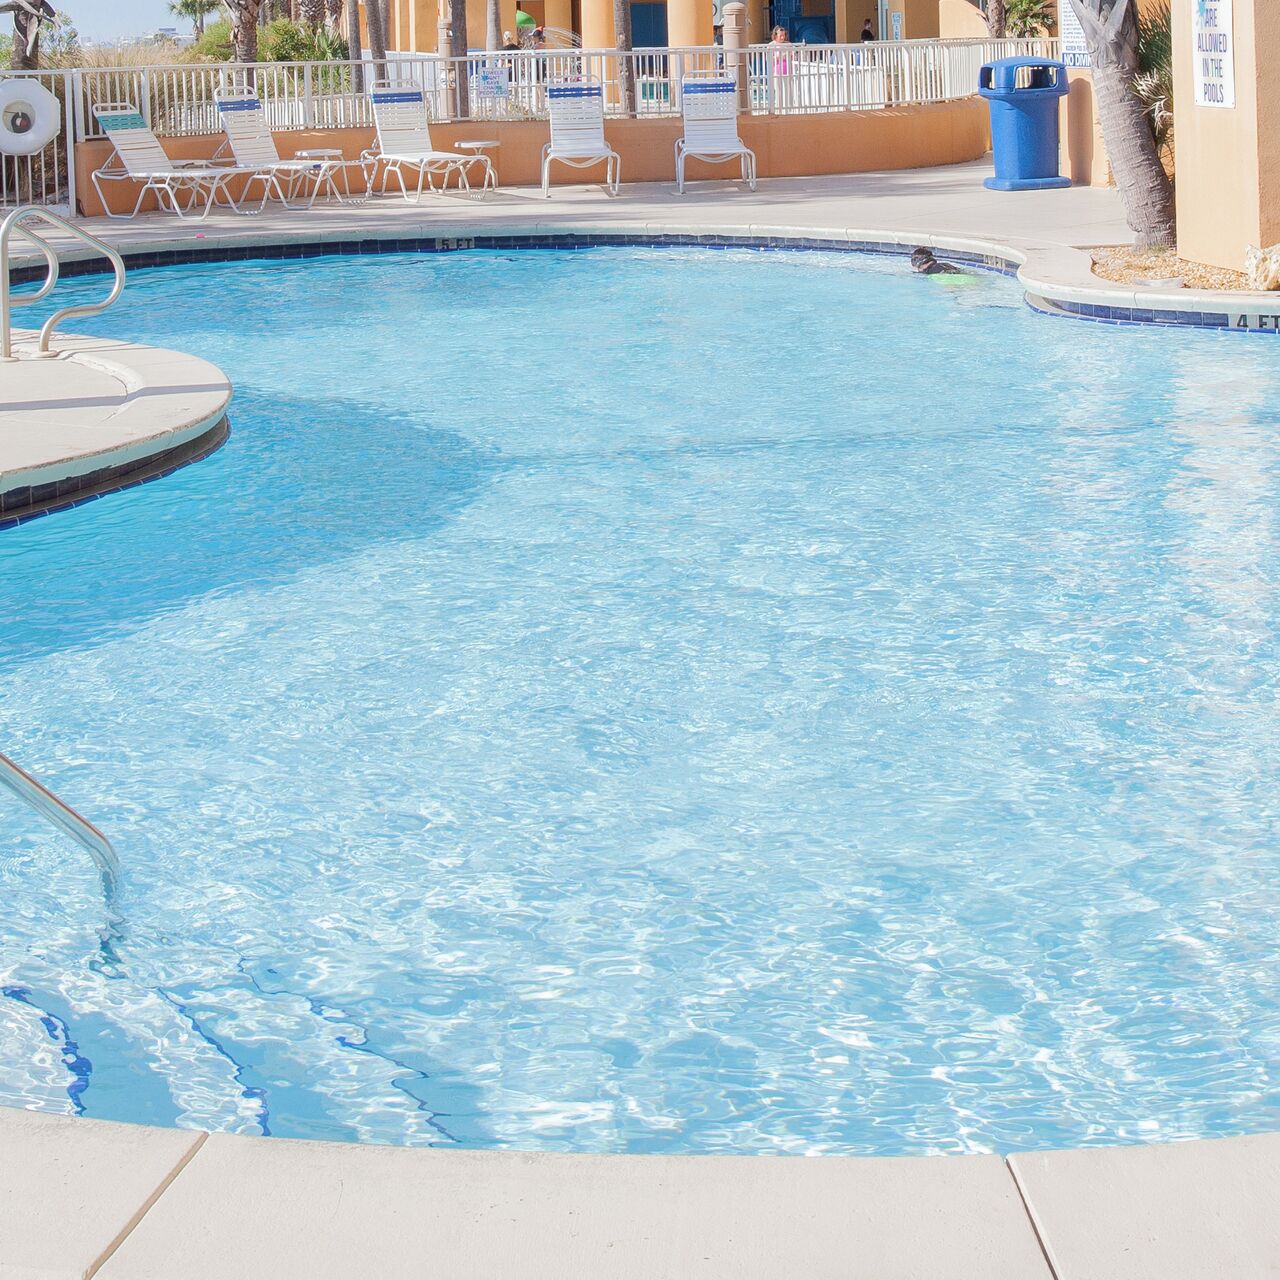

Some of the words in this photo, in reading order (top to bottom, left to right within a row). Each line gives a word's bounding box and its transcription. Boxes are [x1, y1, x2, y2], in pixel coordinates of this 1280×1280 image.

[1204, 8, 1218, 28] ARE
[1197, 33, 1228, 53] ALLOWED
[1064, 53, 1074, 66] NO
[1202, 58, 1210, 77] IN
[1210, 58, 1223, 78] THE
[1203, 83, 1224, 103] POOLS
[441, 239, 450, 250] 5
[457, 239, 472, 249] FT
[1236, 314, 1249, 328] 4
